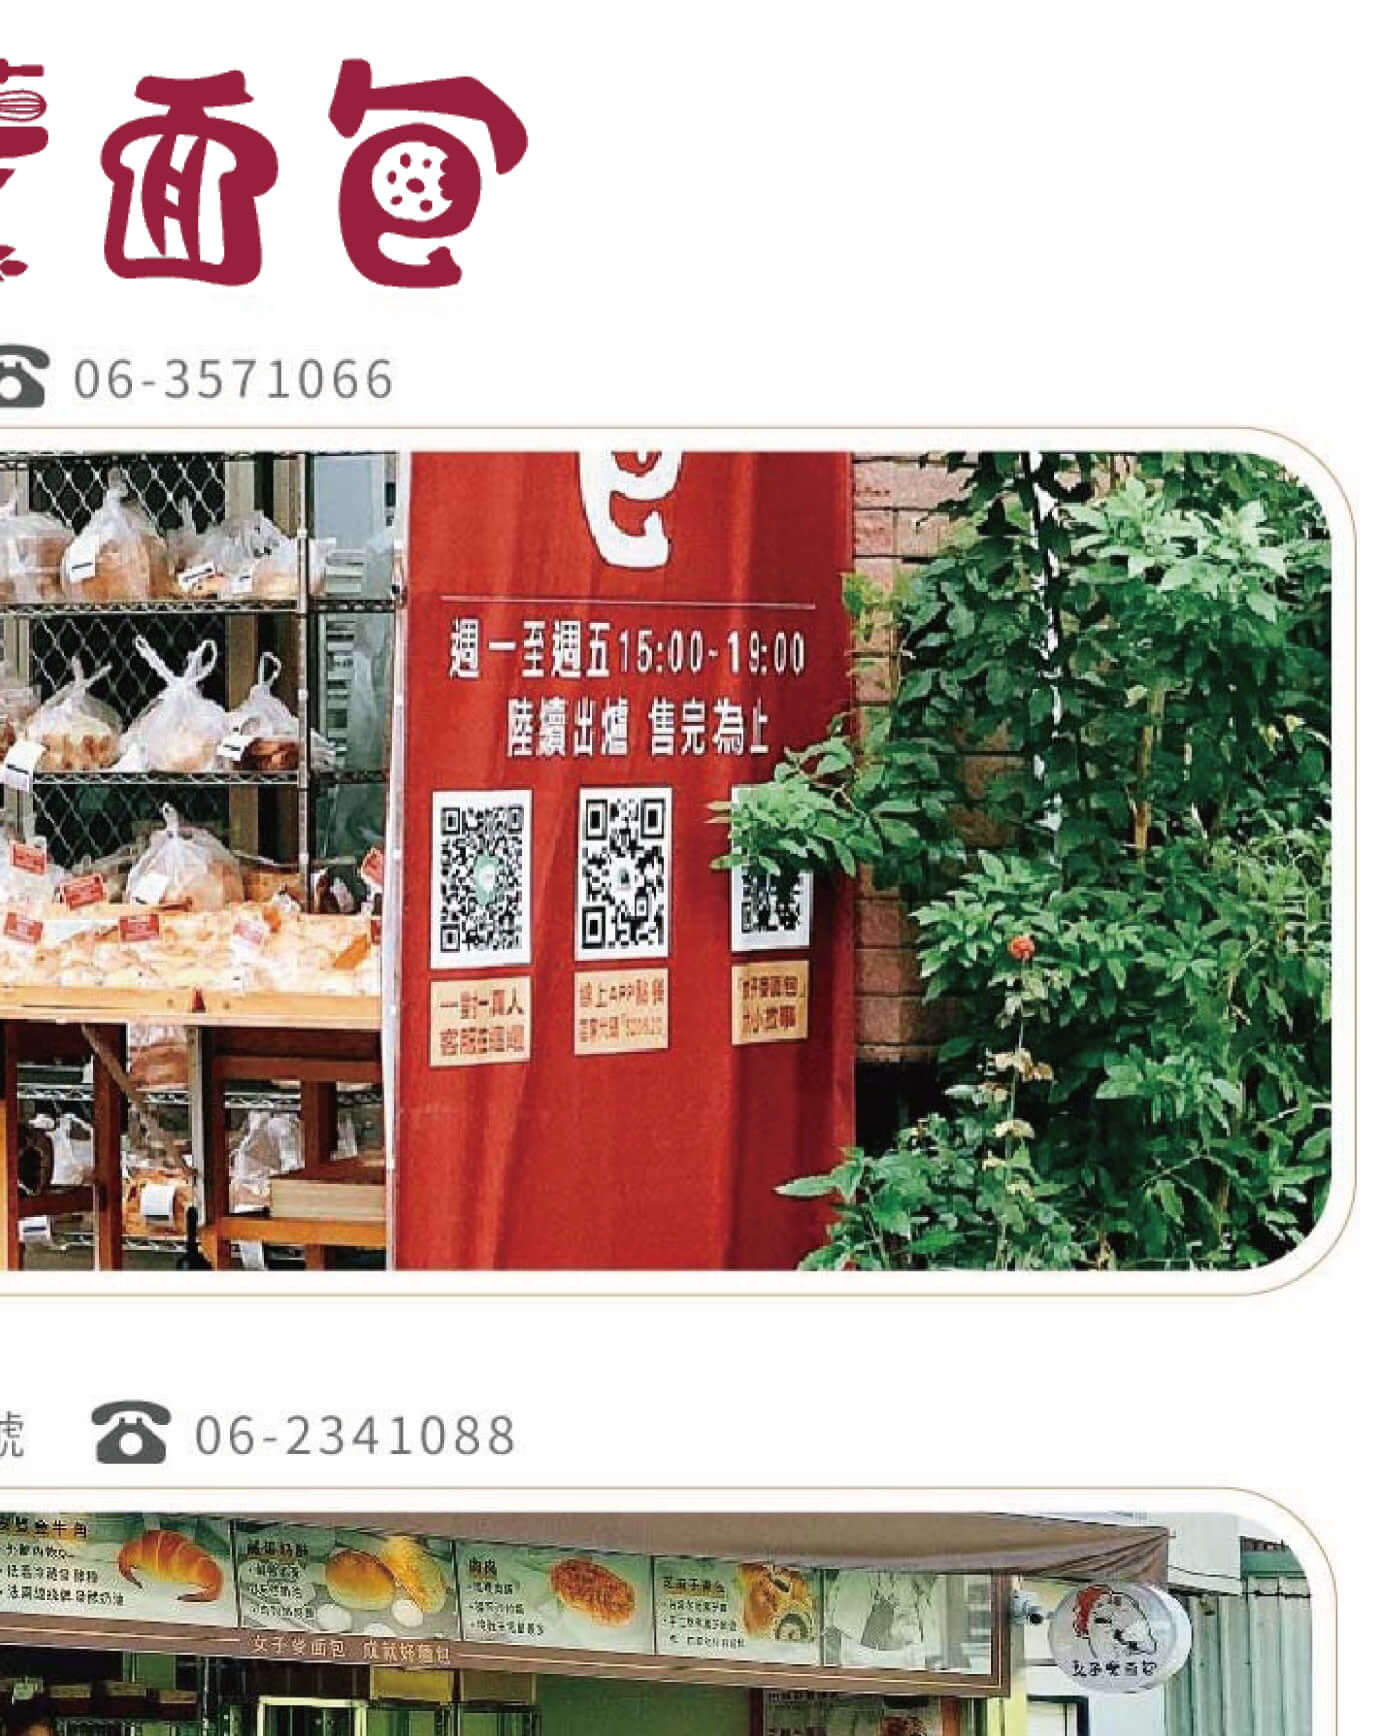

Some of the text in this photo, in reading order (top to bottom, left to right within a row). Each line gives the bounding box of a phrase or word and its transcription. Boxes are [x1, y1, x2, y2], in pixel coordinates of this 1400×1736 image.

[507, 697, 771, 759] 陸續出爐 售完為止
